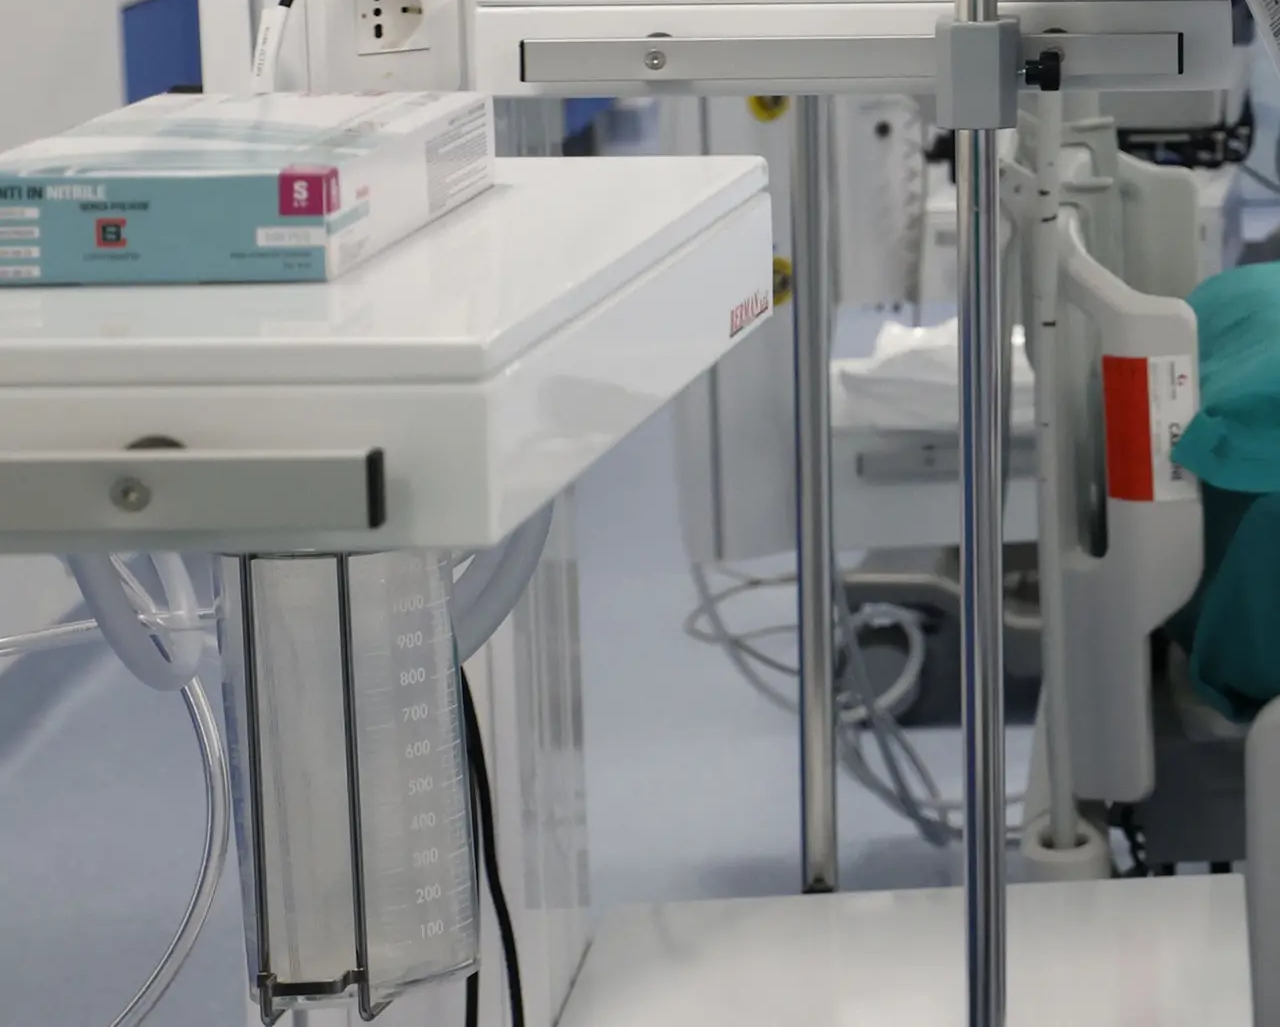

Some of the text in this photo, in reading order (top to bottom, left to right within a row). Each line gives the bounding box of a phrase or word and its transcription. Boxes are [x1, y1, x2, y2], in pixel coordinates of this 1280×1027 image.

[27, 186, 43, 201] IN
[46, 184, 106, 202] NITRILE
[293, 181, 308, 201] S
[397, 631, 423, 649] 900
[399, 667, 426, 686] 800
[402, 704, 428, 722] 700
[405, 740, 431, 759] 600
[408, 776, 433, 795] 500
[411, 812, 436, 830] 400
[413, 848, 438, 867] 300
[416, 884, 441, 904] 200
[420, 920, 444, 939] 100
